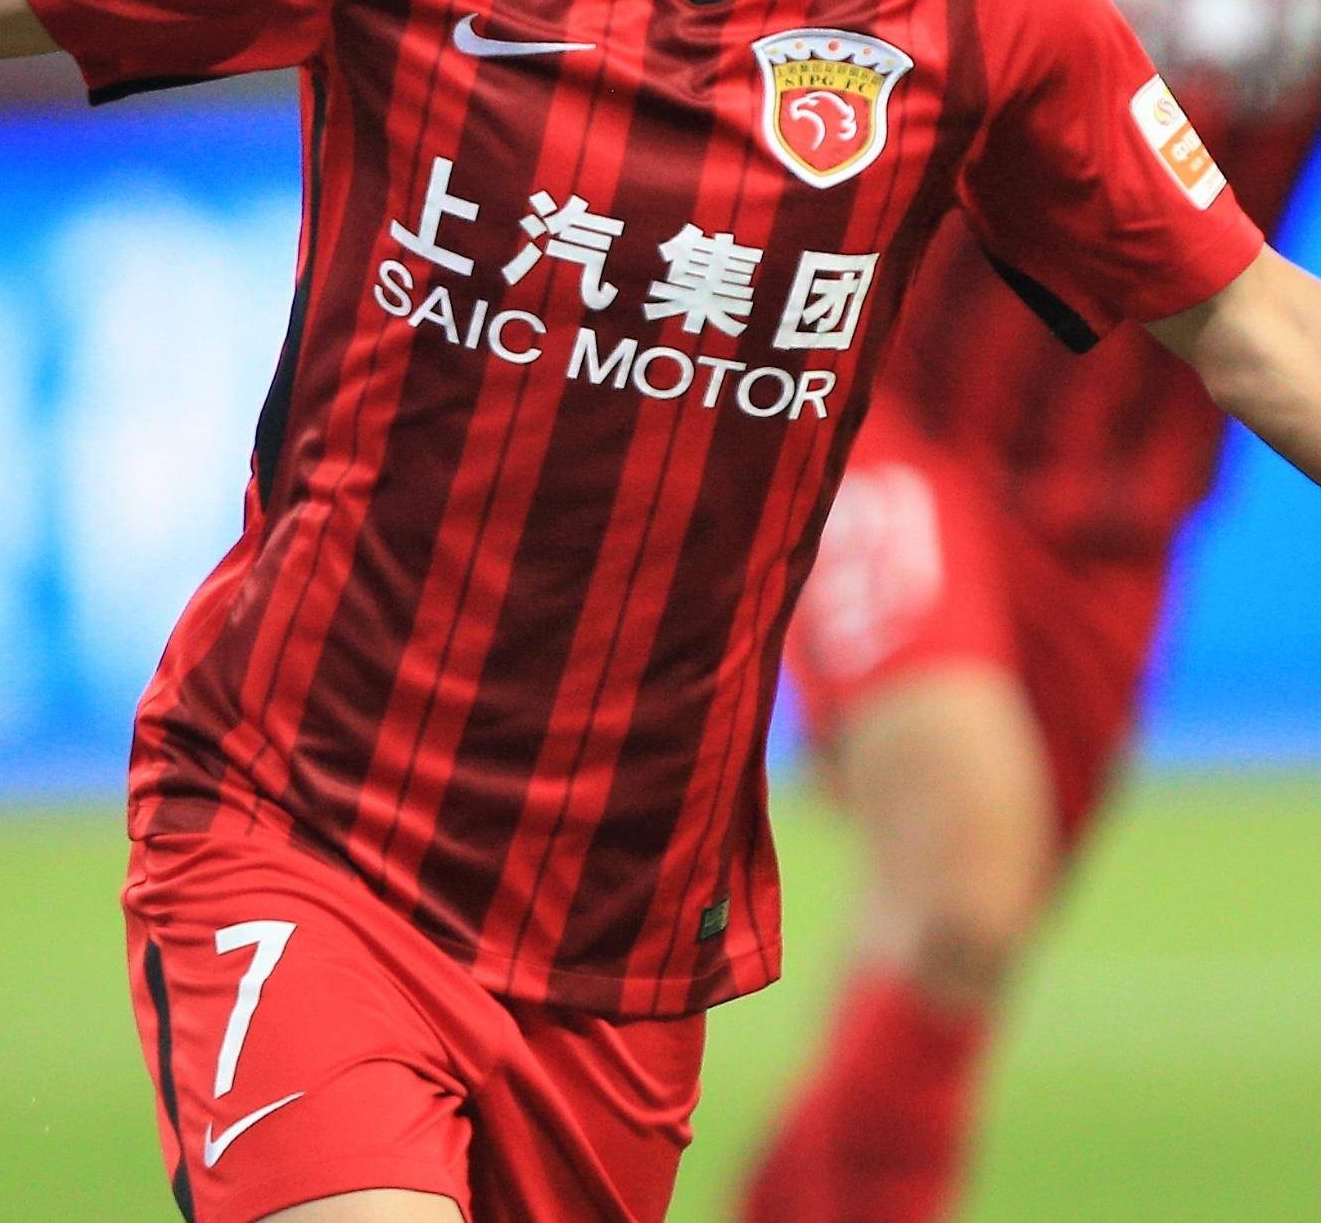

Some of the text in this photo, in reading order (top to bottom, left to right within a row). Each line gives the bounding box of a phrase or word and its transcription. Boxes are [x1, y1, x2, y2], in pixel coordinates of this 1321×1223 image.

[373, 258, 837, 421] SAIC MOTOR
[389, 155, 880, 352] 上汽集团
[213, 919, 299, 1100] 7
